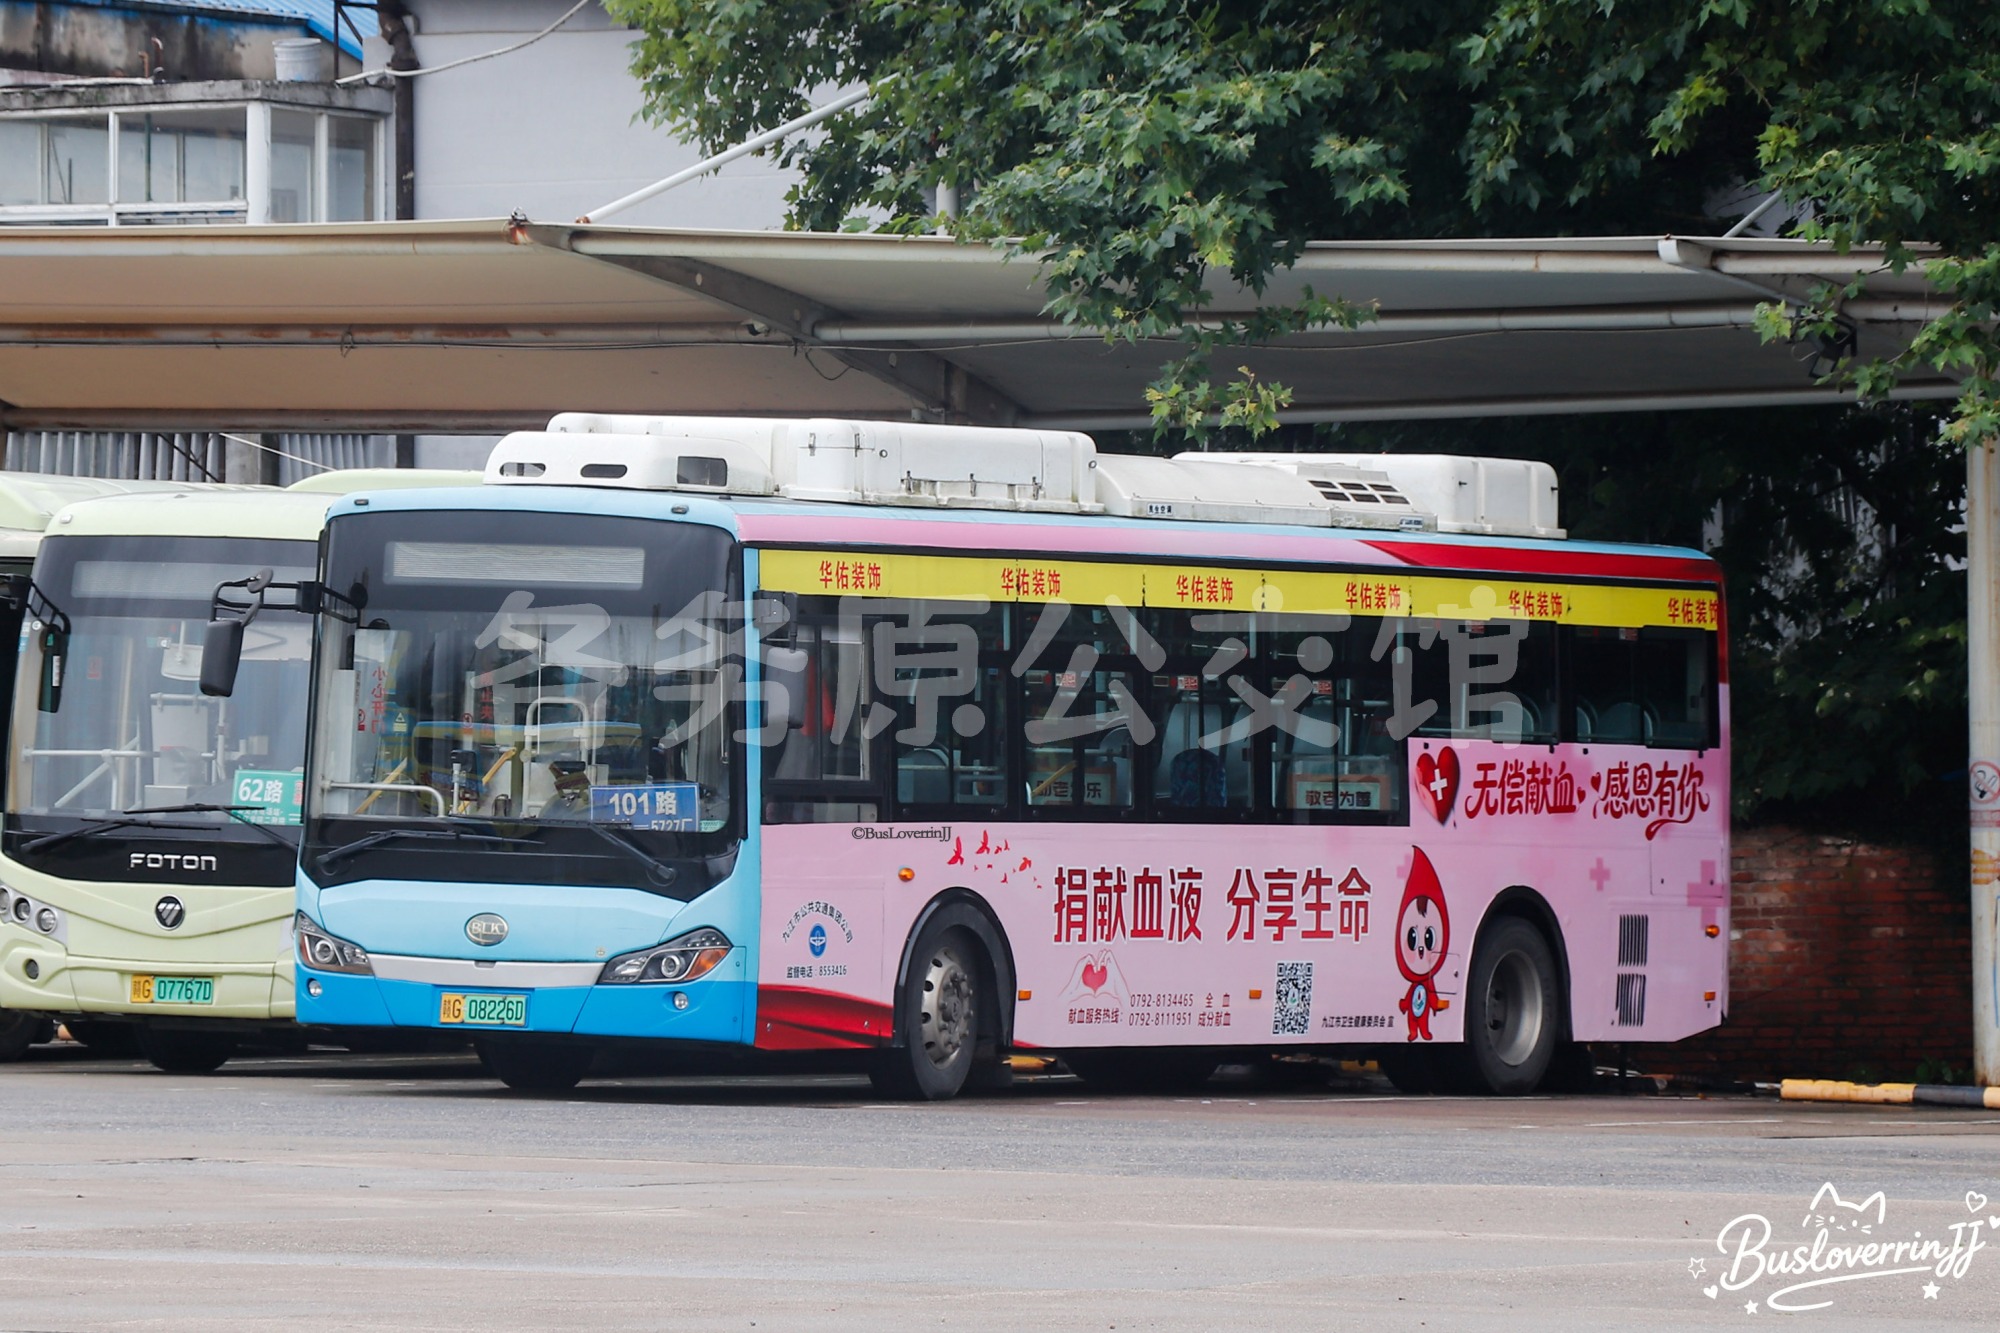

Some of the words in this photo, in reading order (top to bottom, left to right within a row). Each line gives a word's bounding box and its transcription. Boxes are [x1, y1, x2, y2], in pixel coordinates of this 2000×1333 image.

[819, 560, 881, 591] 华佑装饰
[1001, 567, 1061, 597] 华佑装饰
[1176, 574, 1234, 604] 华佑装饰
[1345, 581, 1401, 611] 华佑装饰
[1508, 589, 1563, 618] 华佑装饰
[238, 778, 283, 804] 62路
[1036, 780, 1102, 799] 助老乐
[1464, 758, 1577, 820] 无偿献血
[1597, 760, 1711, 841] 感恩有你
[130, 852, 217, 871] FOTON
[1053, 866, 1204, 944] 捐献血液
[1226, 866, 1372, 943] 分享生命
[471, 921, 507, 935] BLK
[782, 900, 854, 944] 九江市公共交通集团公司
[1130, 993, 1194, 1008] 0792-8134465
[1128, 1012, 1193, 1027] 0792-8111951
[1197, 1011, 1231, 1028] 成分献血
